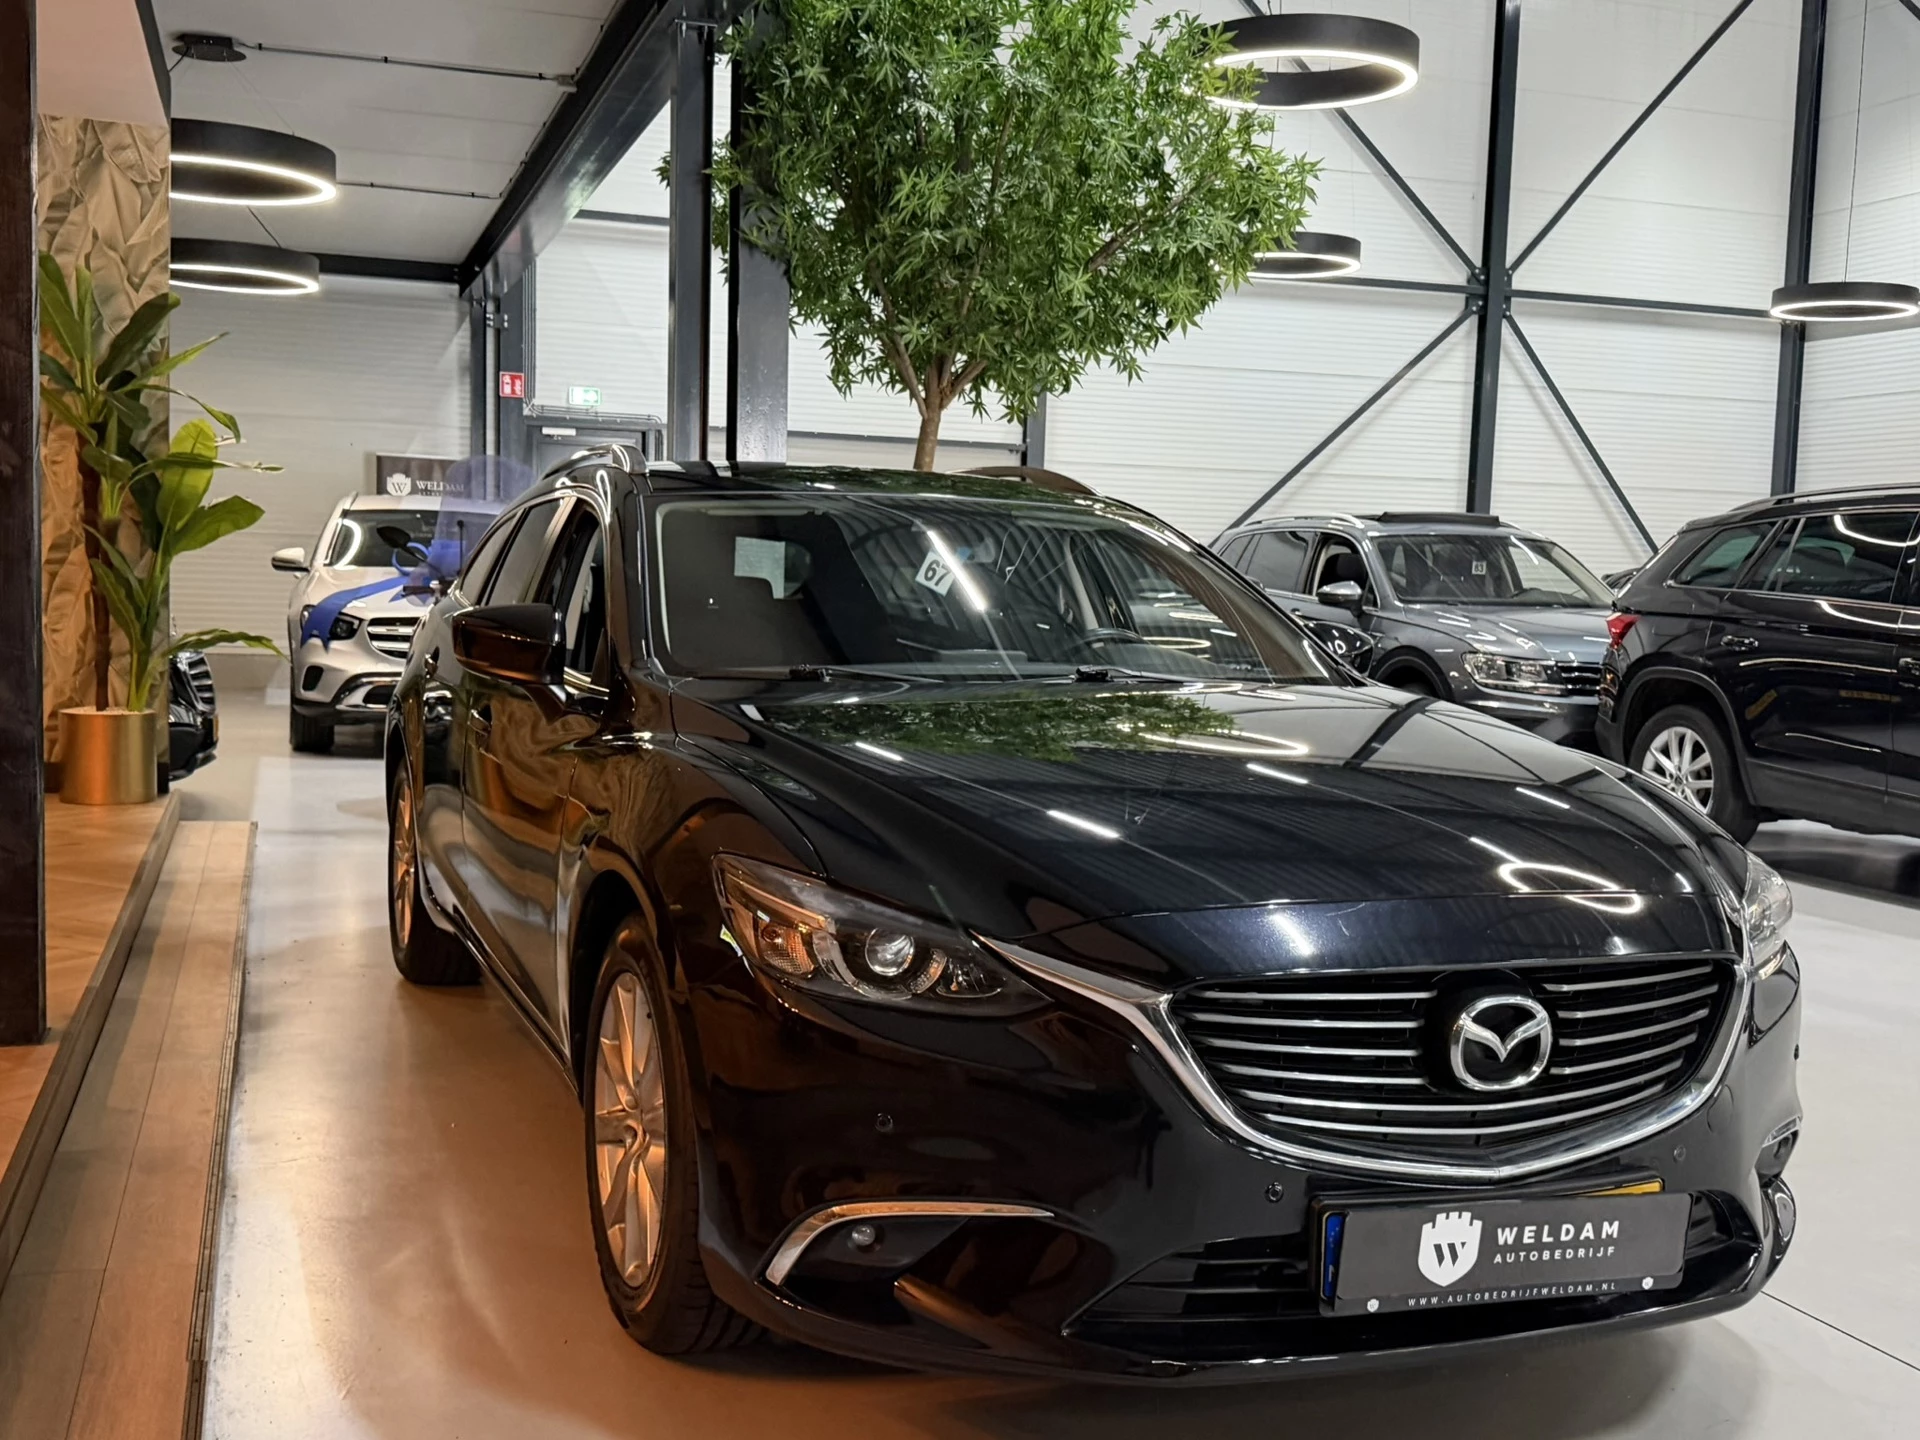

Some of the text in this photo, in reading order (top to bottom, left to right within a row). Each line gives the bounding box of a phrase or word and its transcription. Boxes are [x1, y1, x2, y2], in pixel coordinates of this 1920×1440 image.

[416, 480, 465, 492] WELDAM
[924, 559, 952, 587] 67
[1497, 1220, 1620, 1246] WELDAM
[1493, 1246, 1616, 1264] AUTOBEDRIJF
[1407, 1282, 1616, 1307] WWW.AUTOBEDRIJFWELDAM.NL
